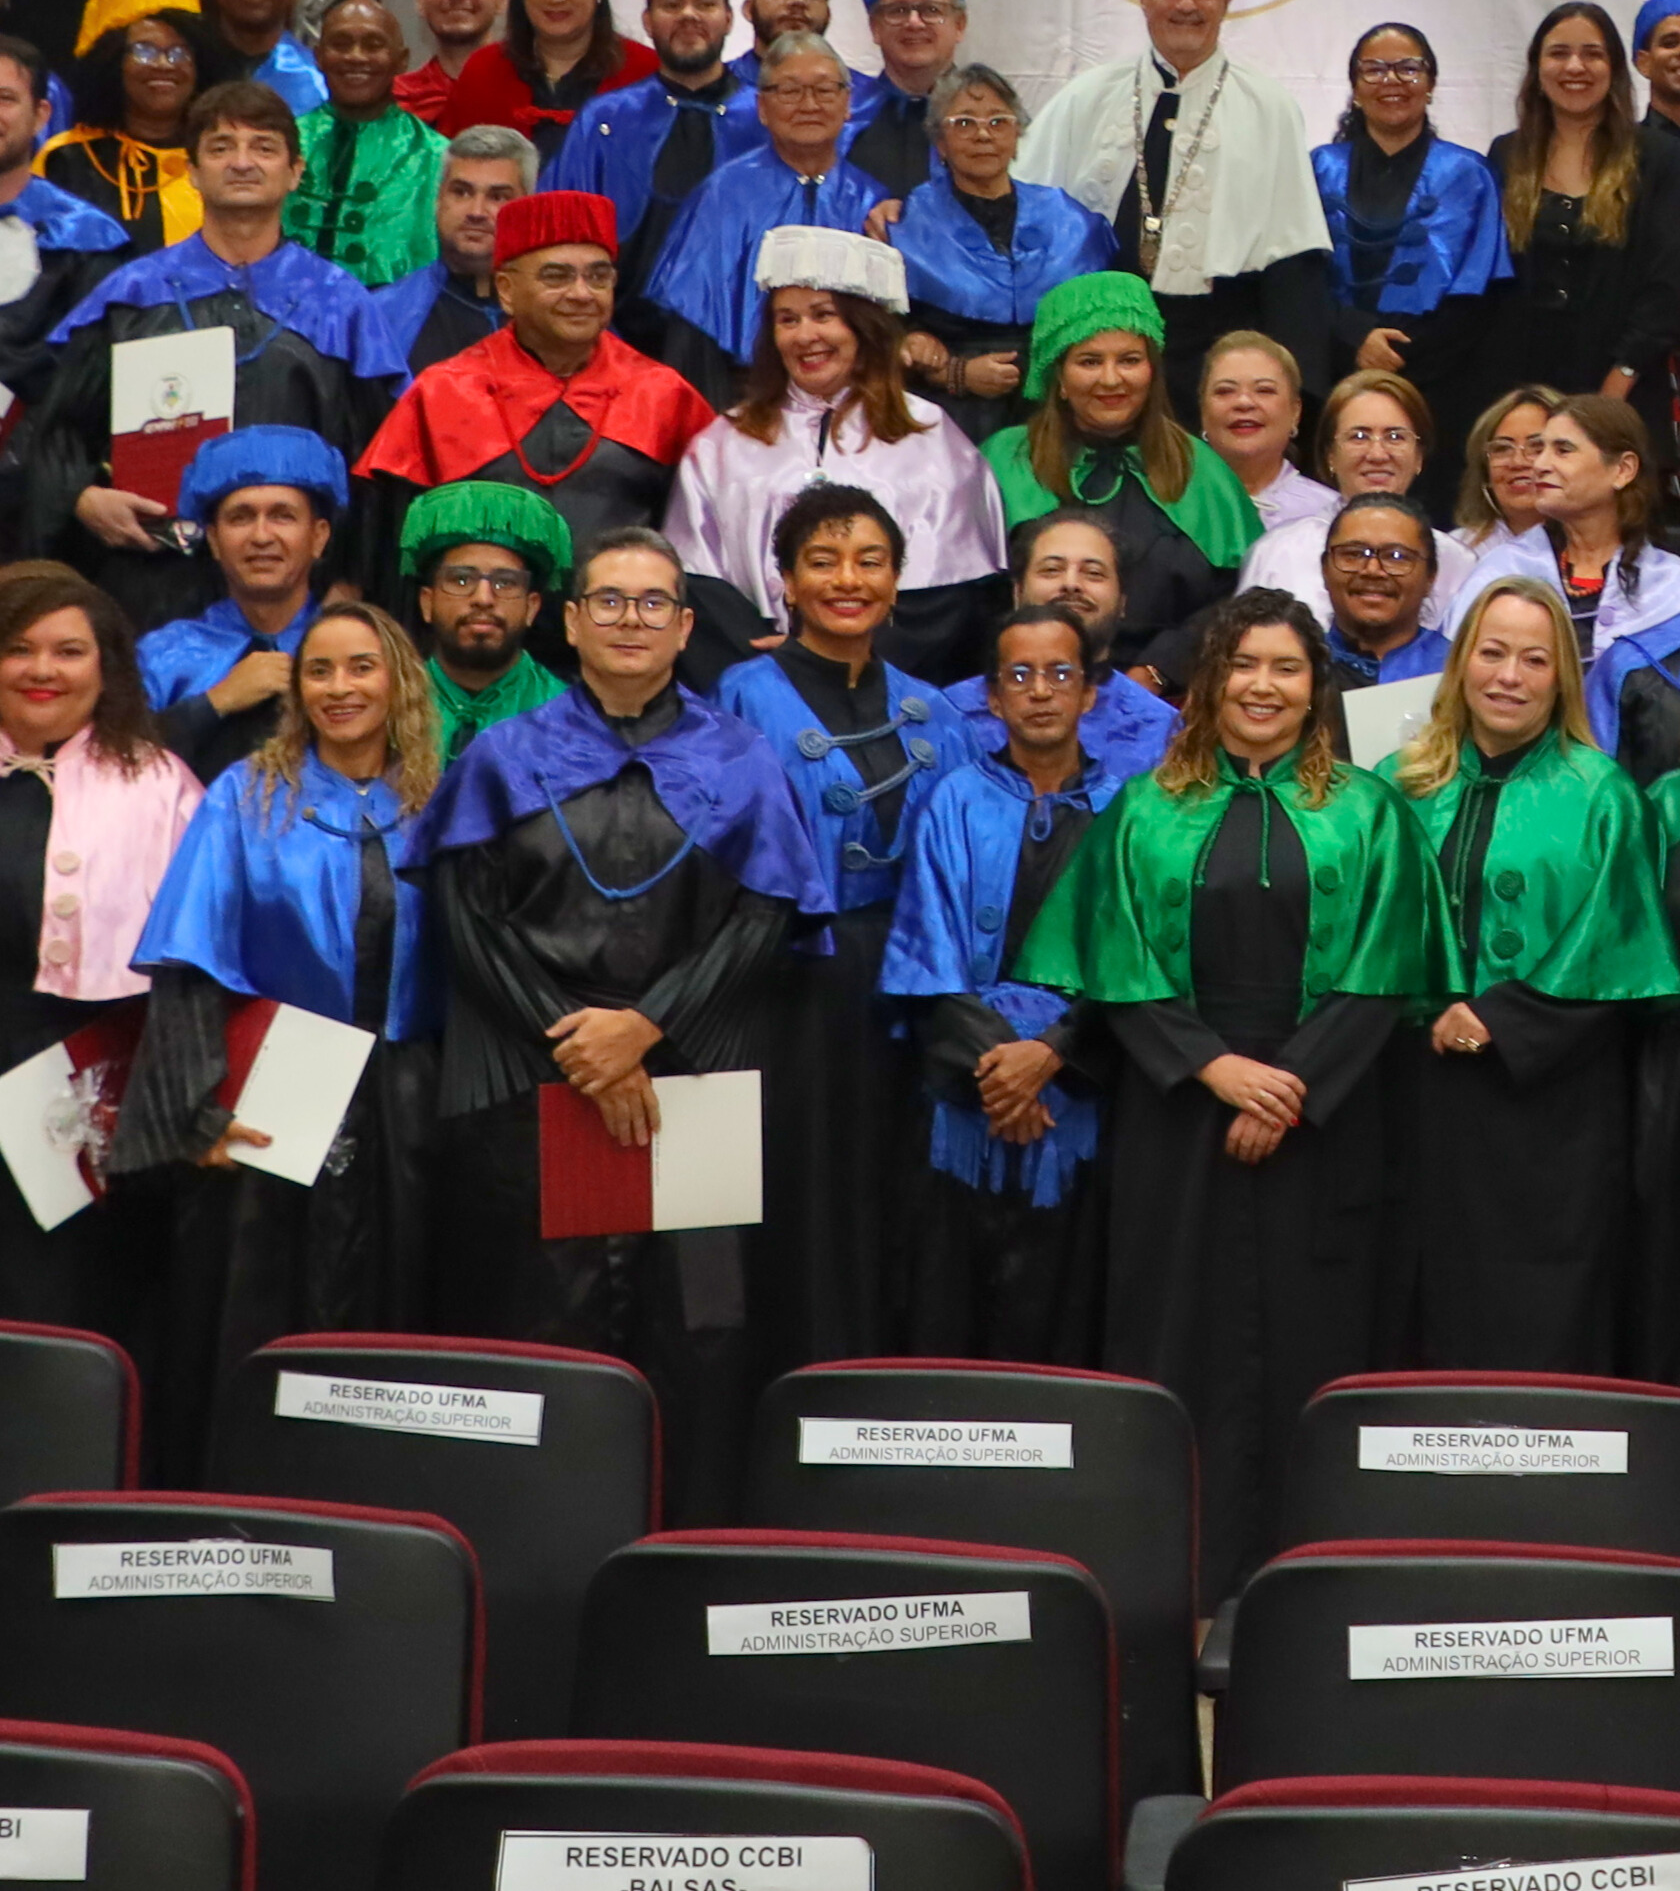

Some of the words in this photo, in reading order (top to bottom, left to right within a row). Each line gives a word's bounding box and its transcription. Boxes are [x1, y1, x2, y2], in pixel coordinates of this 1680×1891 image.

[330, 1383, 433, 1406] RESERVADO
[438, 1390, 487, 1409] UFMA
[303, 1400, 427, 1425] ADMINISTRAÇÃO
[431, 1412, 511, 1430] SUPERIOR
[857, 1427, 962, 1442] RESERVADO
[968, 1428, 1017, 1443] UFMA
[1412, 1433, 1519, 1448] RESERVADO
[1525, 1434, 1574, 1449] UFMA
[829, 1445, 958, 1463] ADMINISTRAÇÃO
[962, 1447, 1043, 1463] SUPERIOR
[1385, 1451, 1514, 1469] ADMINISTRAÇÃO
[1519, 1453, 1600, 1468] SUPERIOR
[120, 1549, 245, 1568] RESERVADO
[250, 1549, 292, 1566] UFMA
[87, 1572, 240, 1592] ADMINISTRAÇÃO
[244, 1573, 312, 1590] SUPERIOR
[771, 1603, 898, 1628] RESERVADO
[905, 1599, 964, 1619] UFMA
[740, 1626, 895, 1653] ADMINISTRAÇÃO
[899, 1621, 997, 1645] SUPERIOR
[1415, 1628, 1542, 1648] RESERVADO
[1549, 1627, 1609, 1645] UFMA
[1382, 1650, 1538, 1672] ADMINISTRAÇÃO
[1543, 1649, 1641, 1668] SUPERIOR
[566, 1846, 730, 1869] RESERVADO
[739, 1846, 802, 1869] CCBI
[1591, 1865, 1655, 1890] CCBI
